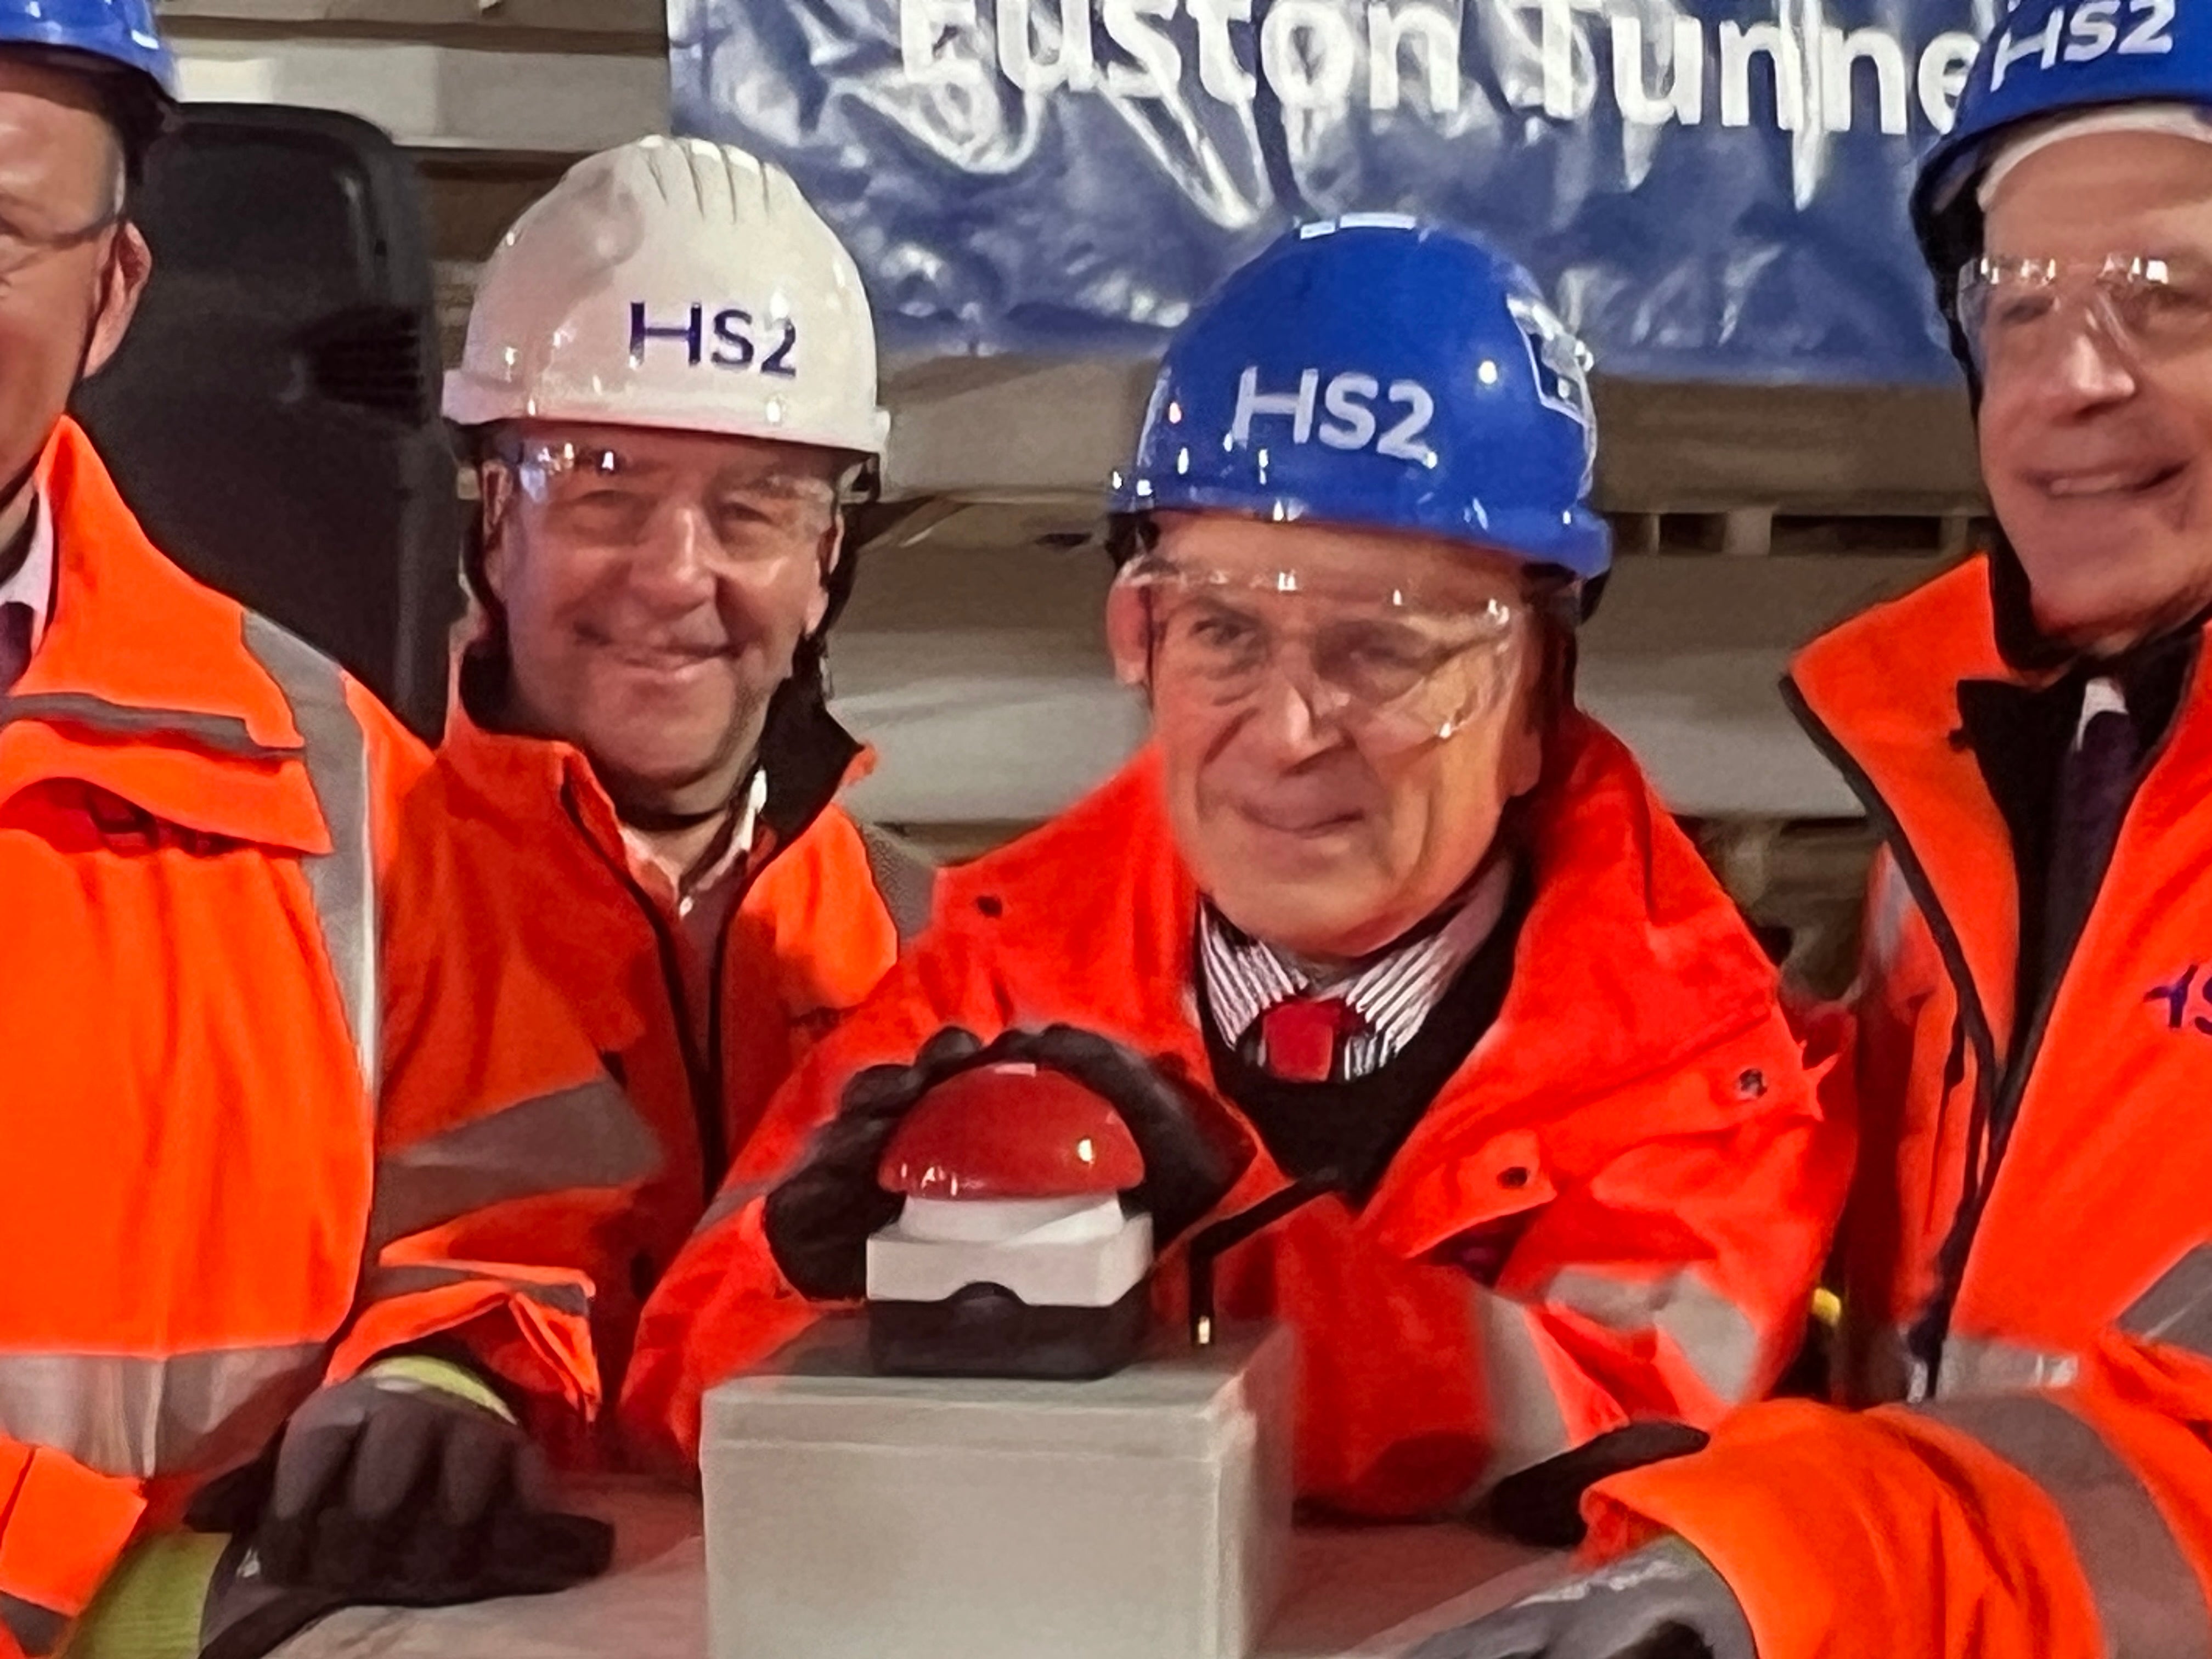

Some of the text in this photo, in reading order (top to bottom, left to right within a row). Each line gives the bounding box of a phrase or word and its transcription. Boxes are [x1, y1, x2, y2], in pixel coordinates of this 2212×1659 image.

[901, 0, 1995, 134] Euston Tunne
[1989, 0, 2176, 92] HS2
[629, 301, 797, 377] HS2
[1231, 365, 1435, 462] HS2
